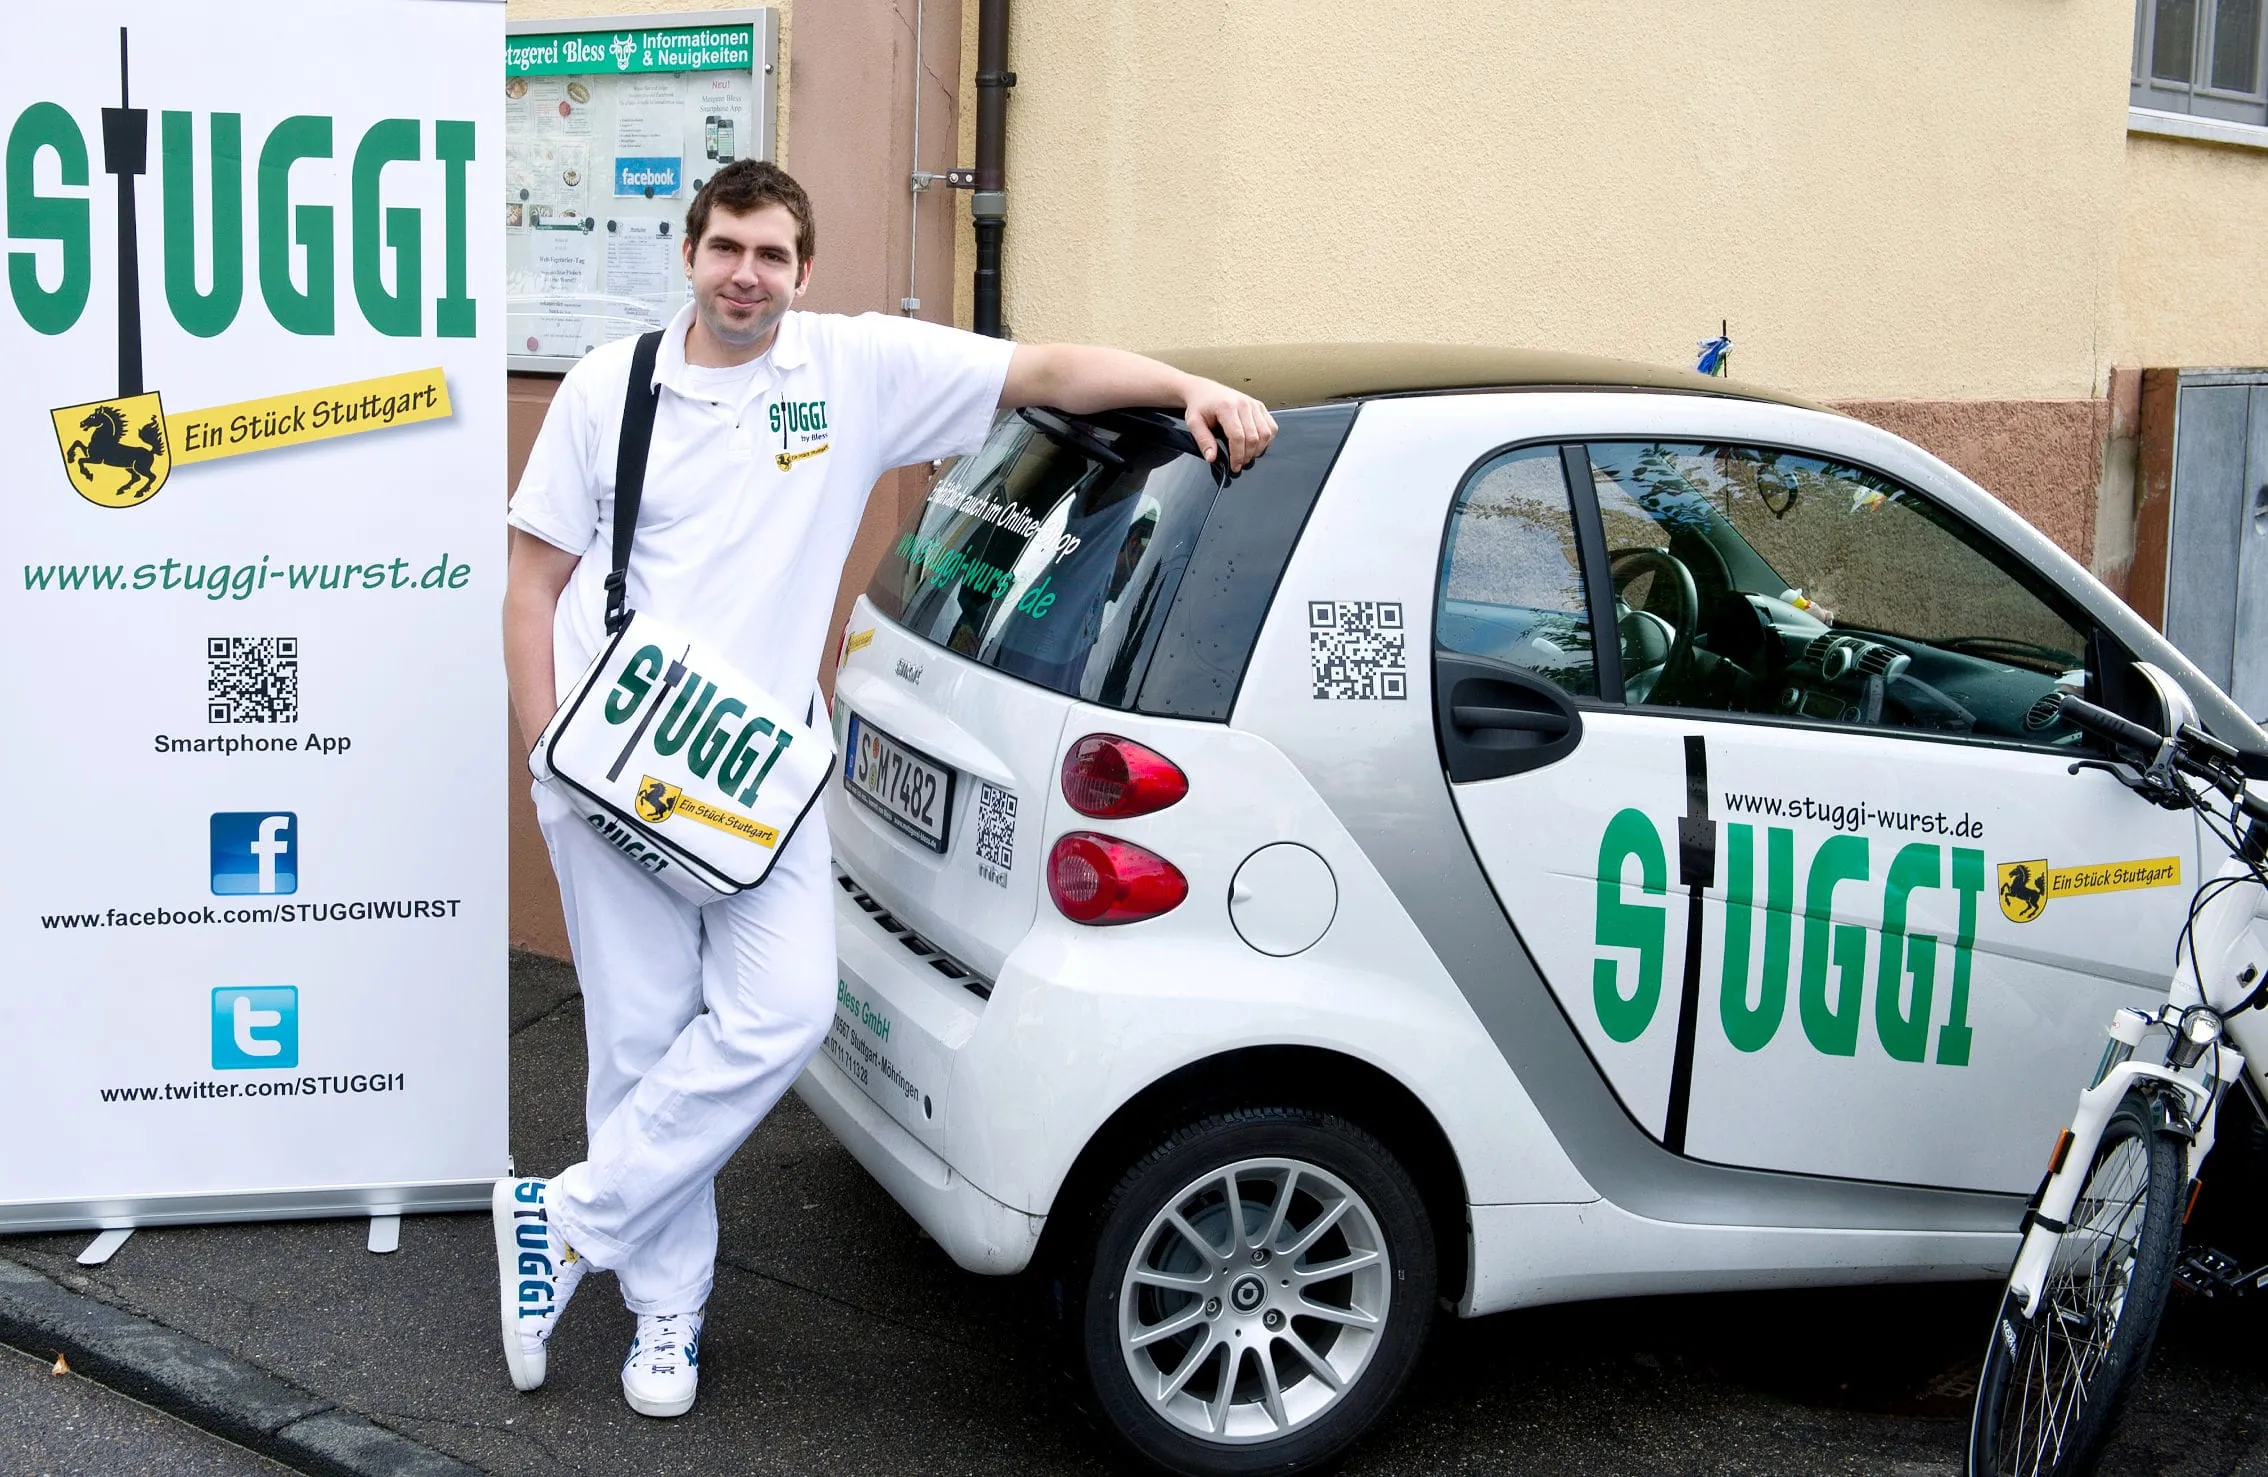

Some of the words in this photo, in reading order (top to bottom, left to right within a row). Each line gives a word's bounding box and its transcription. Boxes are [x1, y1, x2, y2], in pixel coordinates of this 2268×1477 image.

[562, 38, 604, 62] Bless
[643, 31, 748, 48] Informationen
[643, 52, 653, 66] &
[659, 48, 748, 67] Neuigkeiten
[622, 168, 674, 185] facebook
[6, 27, 476, 394] STUGGI
[185, 422, 222, 452] Ein
[229, 405, 306, 444] Stück
[312, 384, 437, 428] Stuttgart
[770, 392, 828, 450] STUGGI
[24, 553, 471, 600] www.stuggi-wurst.de
[154, 734, 298, 756] Smartphone
[304, 733, 352, 755] App
[604, 644, 794, 808] STUGGI
[859, 732, 870, 782] S
[679, 799, 696, 812] Ein
[695, 805, 726, 824] Stück
[724, 817, 773, 840] Stuttgart
[1725, 792, 1984, 838] www.stuggi-wurst.de
[2052, 874, 2072, 890] Ein
[2074, 870, 2111, 888] Stück
[2113, 864, 2174, 884] Stuttgart
[41, 899, 460, 929] www.facebook.com/STUGGIWURST
[1593, 735, 1985, 1155] STUGGI
[838, 978, 860, 1016] Bless
[862, 1002, 890, 1043] GmbH
[100, 1073, 405, 1103] www.twitter.com/STUGGI1
[514, 1182, 554, 1318] STUGGI
